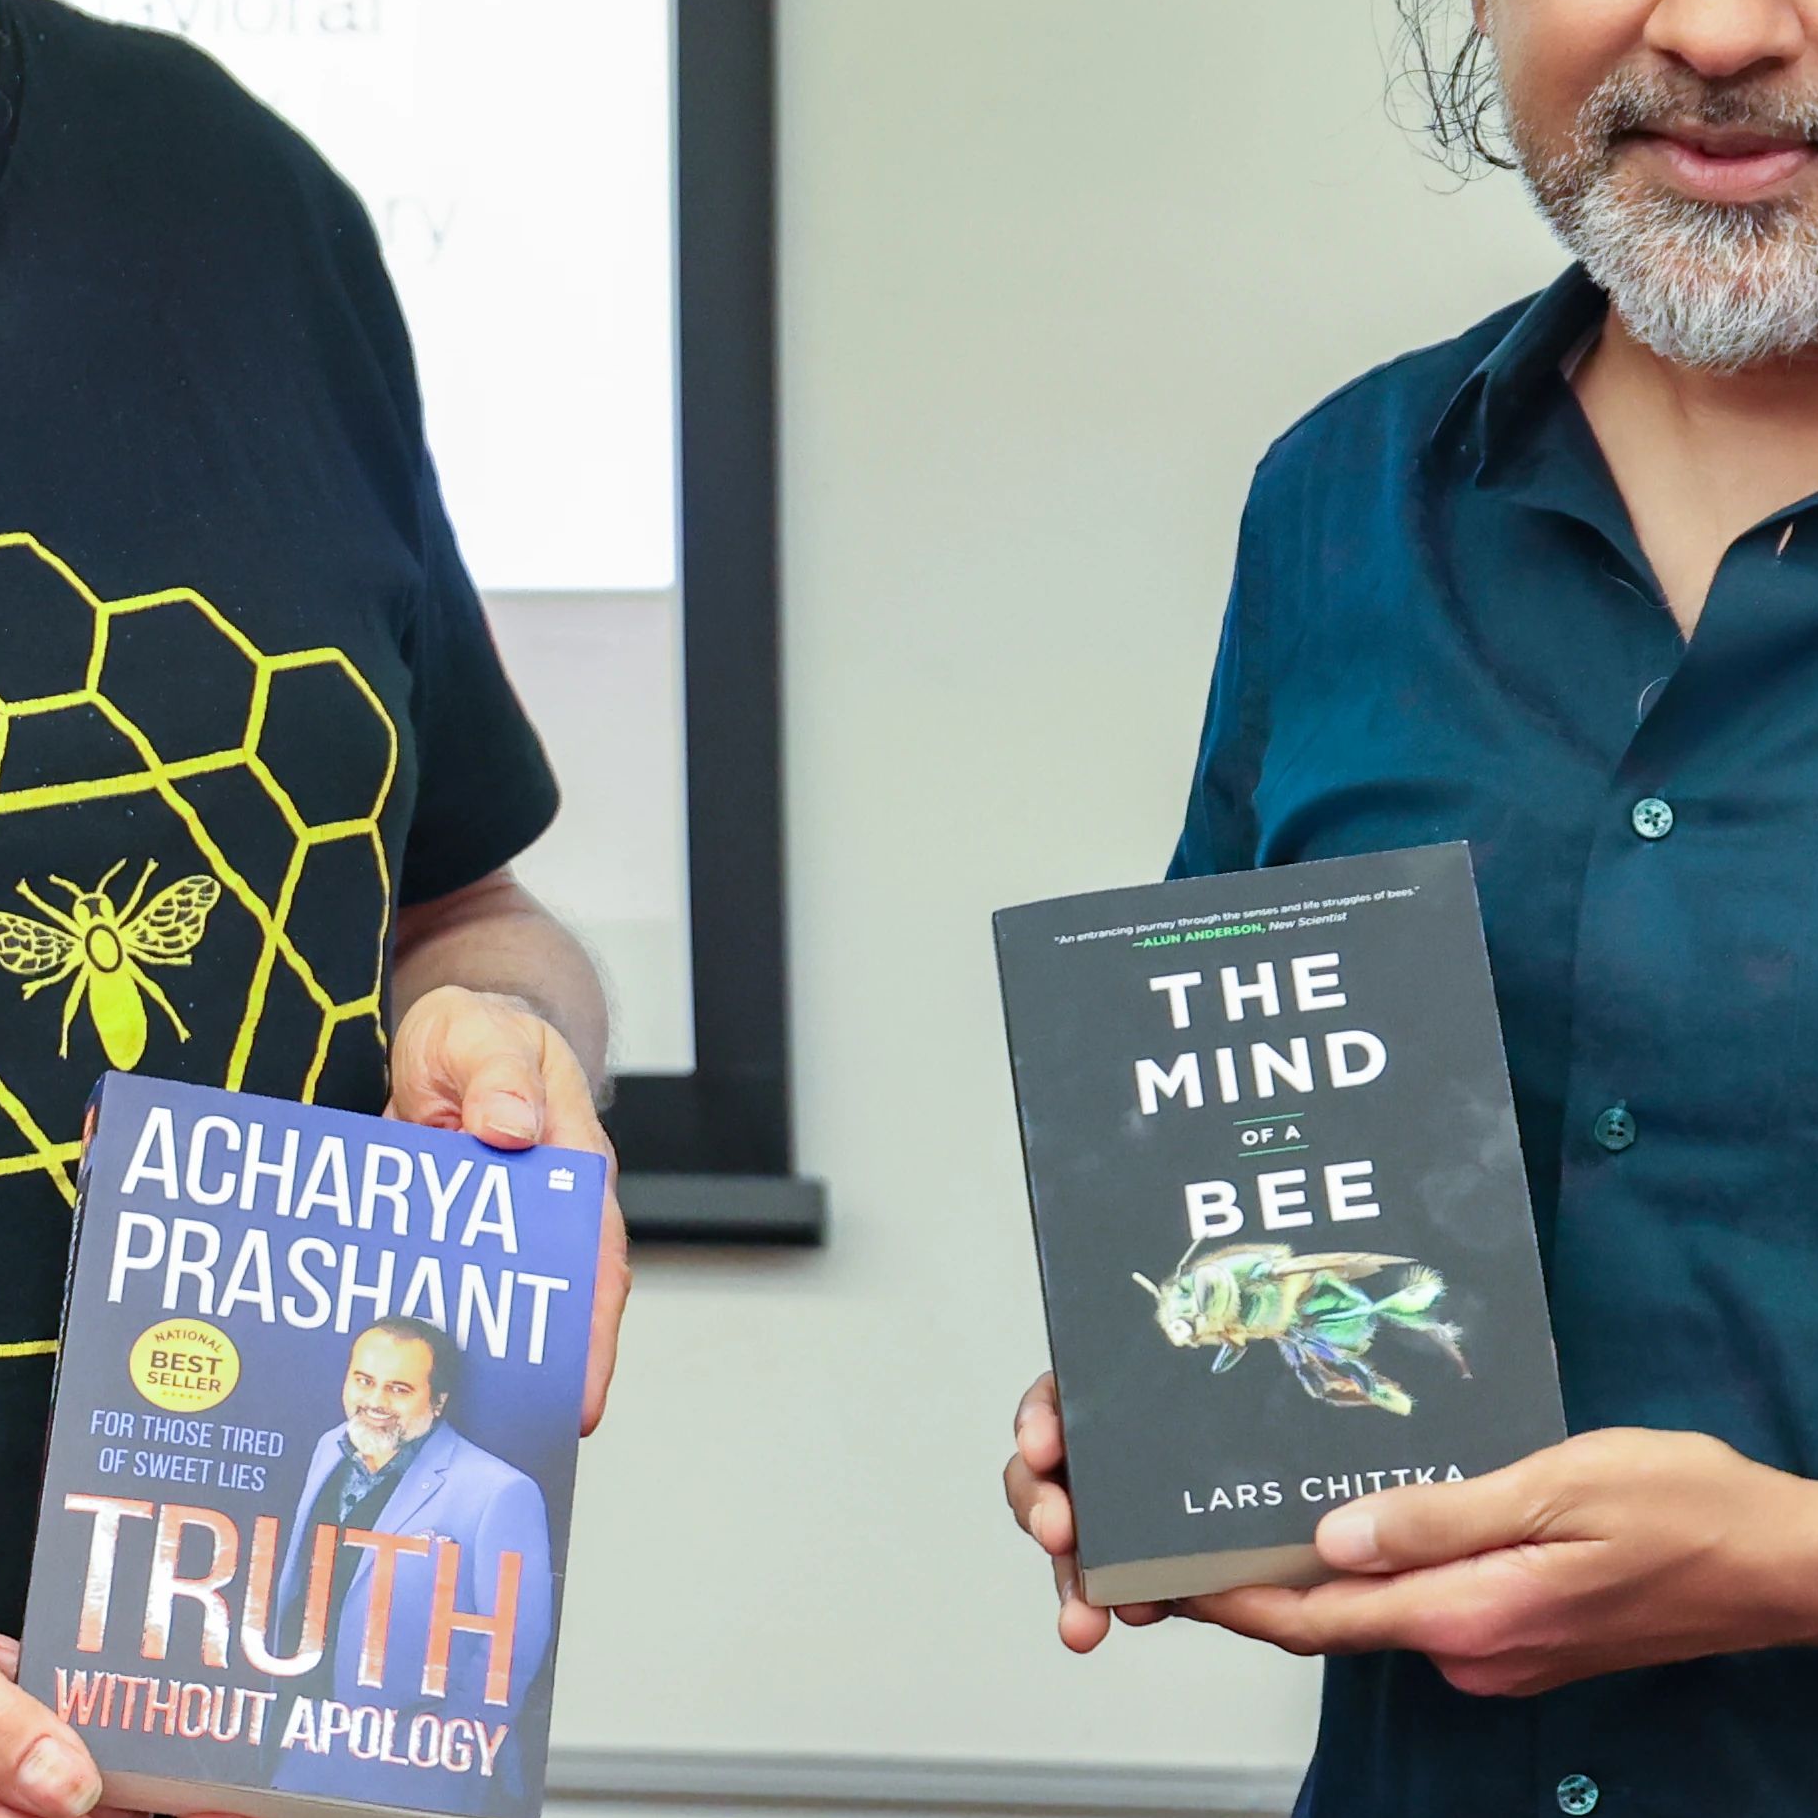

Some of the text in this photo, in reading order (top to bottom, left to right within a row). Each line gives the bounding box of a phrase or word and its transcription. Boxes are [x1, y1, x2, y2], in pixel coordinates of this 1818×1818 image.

[1076, 926, 1133, 942] entrancing
[1135, 920, 1176, 934] journey
[1178, 914, 1222, 927] through
[1222, 911, 1241, 922] the
[1243, 907, 1279, 920] senses
[1281, 903, 1302, 914] and
[1303, 900, 1321, 911] life
[1322, 894, 1372, 909] struggles
[1374, 890, 1385, 901] of
[1184, 922, 1267, 943] ANDERSON,
[1268, 919, 1296, 932] New
[1298, 911, 1348, 928] Scientist
[1149, 952, 1349, 1030] THE
[1134, 1028, 1388, 1116] MIND
[1241, 1124, 1302, 1146] OF A
[119, 1107, 519, 1254] ACHARYA
[1183, 1159, 1381, 1240] BEE
[107, 1212, 570, 1365] PRASHANT
[150, 1350, 223, 1375] BEST
[154, 1329, 223, 1353] NATIONAL
[146, 1371, 221, 1392] SELLER
[90, 1409, 284, 1457] FOR THOSE TIRED
[98, 1447, 267, 1492] OF SWEET LIES
[1183, 1463, 1465, 1514] LARS CHITTKA
[63, 1493, 523, 1709] TRUTH
[54, 1667, 511, 1778] WITHOUT APOLOGY
